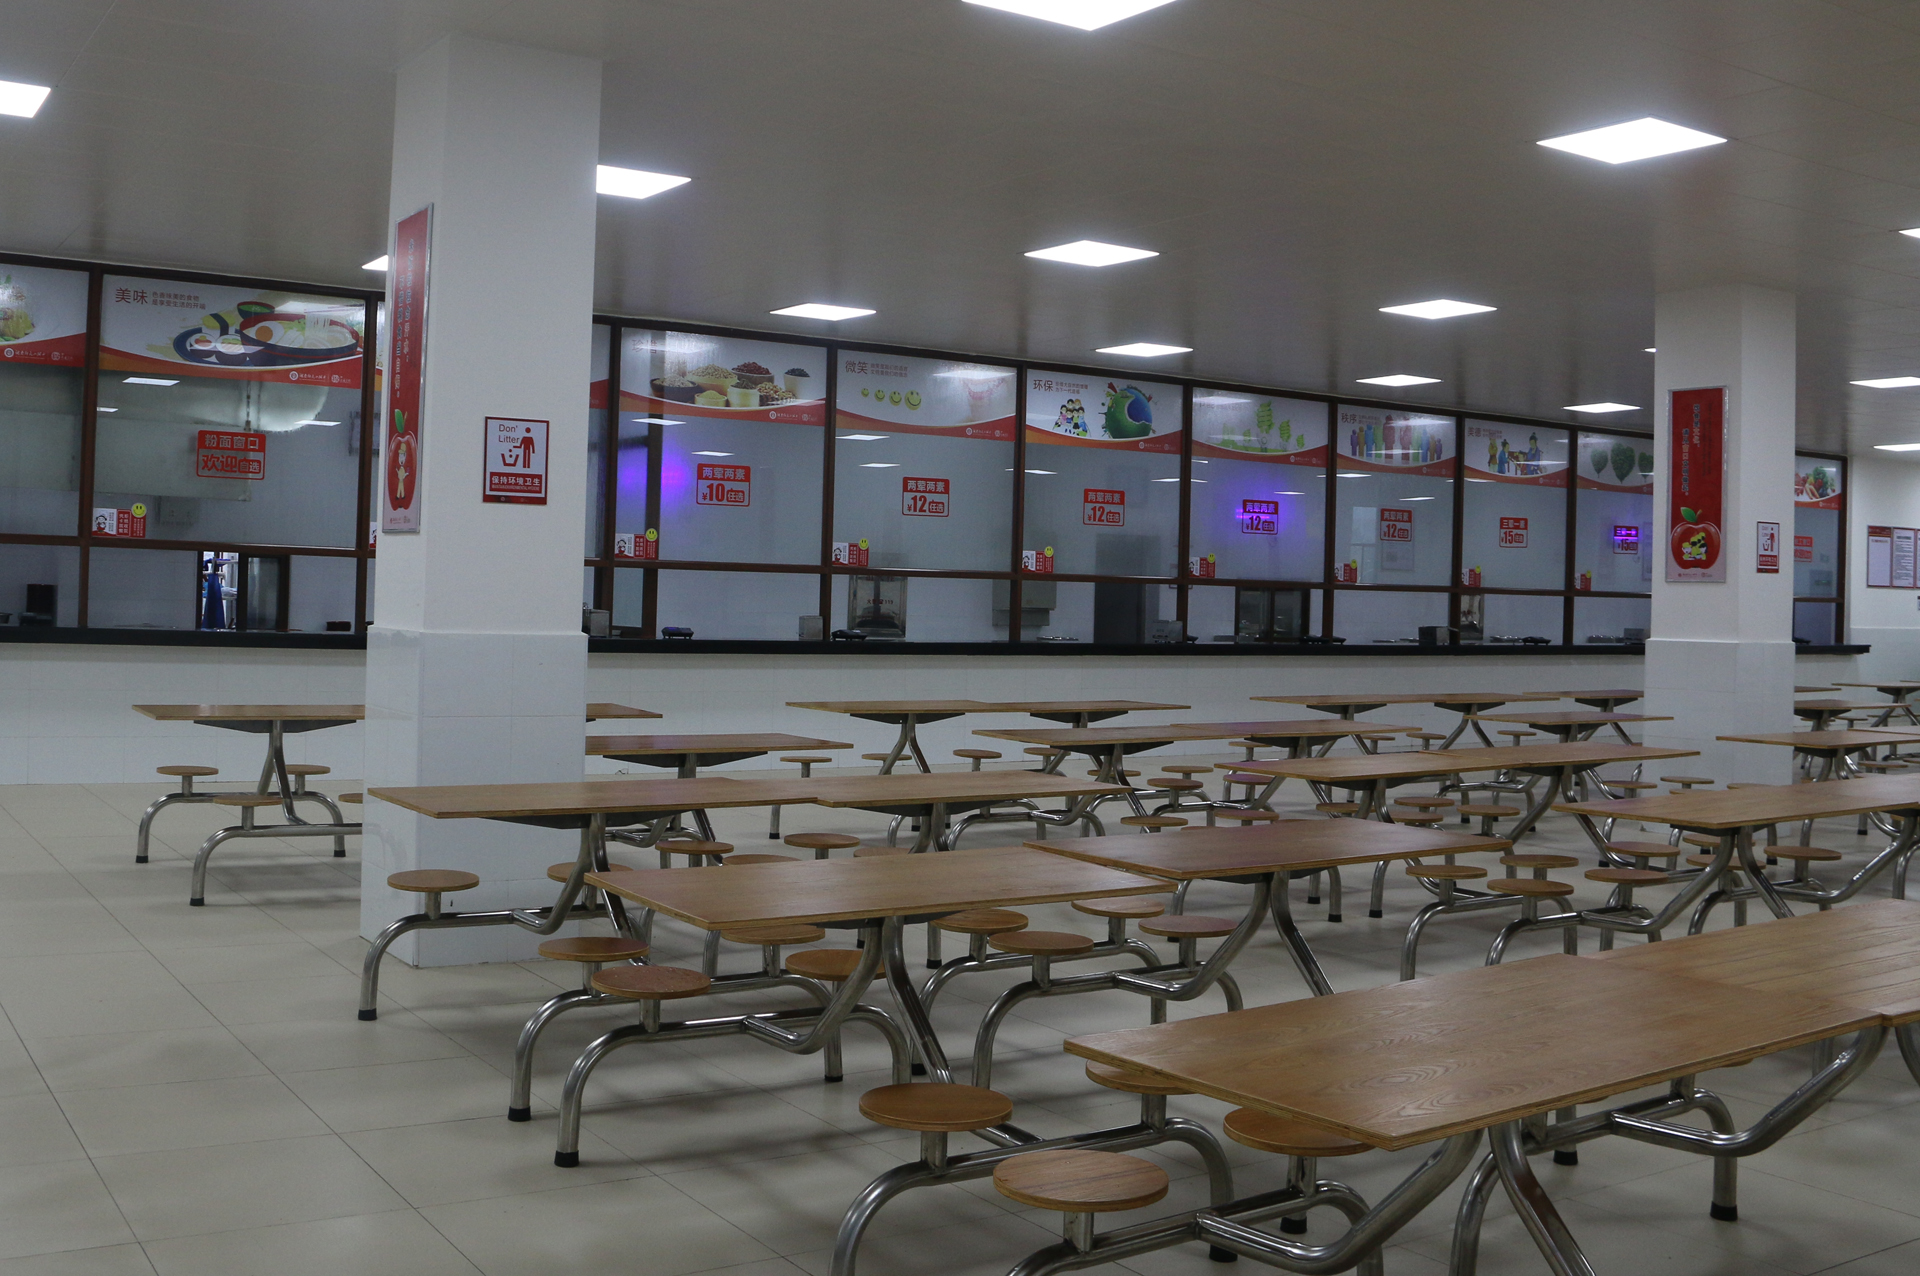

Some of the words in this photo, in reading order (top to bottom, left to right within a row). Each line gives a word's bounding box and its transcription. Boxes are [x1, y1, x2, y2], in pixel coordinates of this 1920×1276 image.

[115, 287, 148, 305] 美味
[152, 291, 200, 302] 色香味美的食物
[152, 299, 206, 310] 是享受生活的开端
[845, 360, 869, 375] 微笑
[1033, 379, 1053, 392] 环保
[1341, 412, 1357, 424] 秩序
[498, 424, 518, 433] Don'
[1467, 426, 1482, 438] 美德
[205, 434, 259, 449] 粉面窗口
[498, 435, 520, 443] Litter
[702, 466, 746, 480] 两荤两素
[492, 475, 541, 486] 保持环境卫生
[907, 480, 945, 492] 两荤两素
[1088, 491, 1121, 503] 两荤两素
